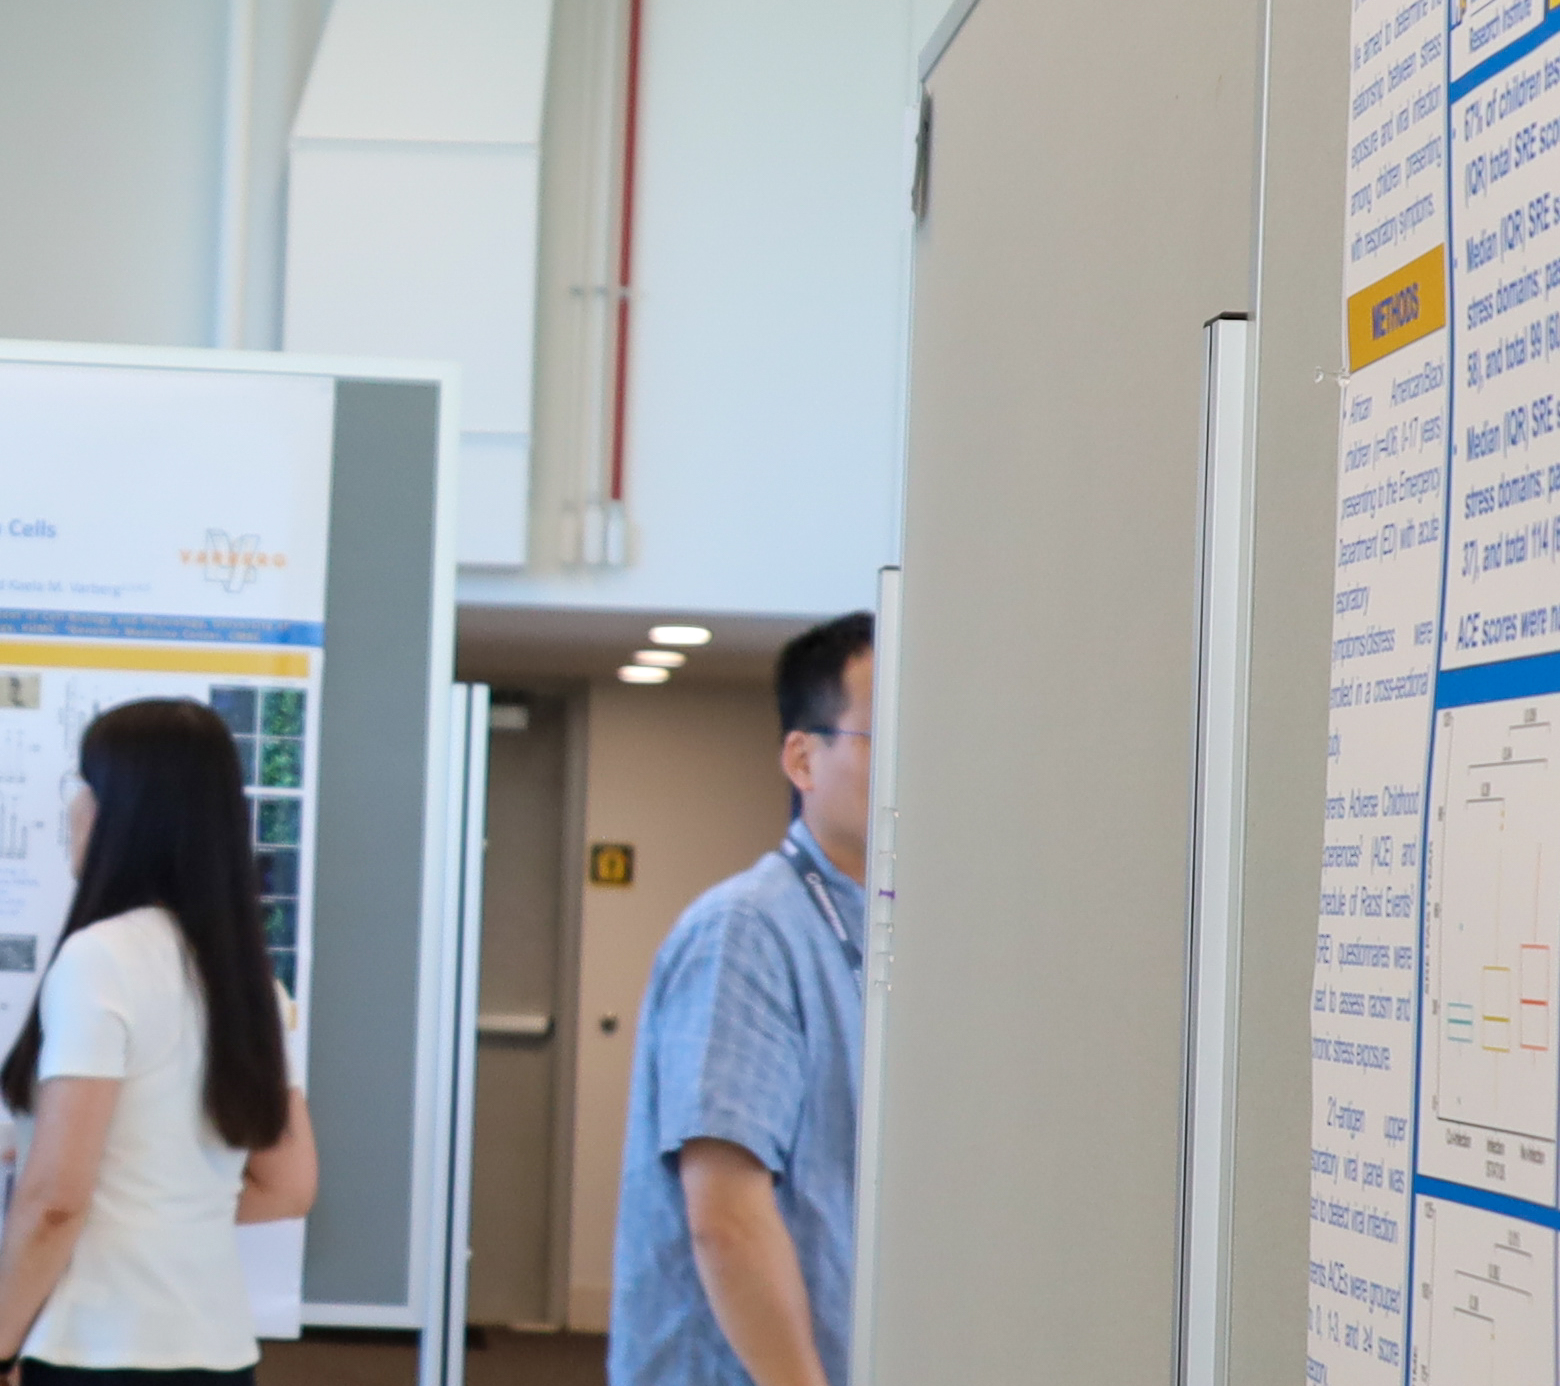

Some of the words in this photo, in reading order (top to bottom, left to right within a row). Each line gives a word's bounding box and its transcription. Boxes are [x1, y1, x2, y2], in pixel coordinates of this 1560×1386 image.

[1484, 85, 1498, 129] of
[1498, 66, 1542, 121] children
[1489, 136, 1515, 185] total
[1513, 120, 1539, 171] SRE
[1465, 228, 1499, 275] Median
[1499, 205, 1526, 264] (IQR)
[1527, 190, 1552, 240] SRE
[1466, 291, 1495, 332] stress
[8, 518, 58, 539] Cells
[1455, 610, 1481, 652] ACE
[1481, 615, 1518, 647] scores
[1519, 610, 1548, 640] were
